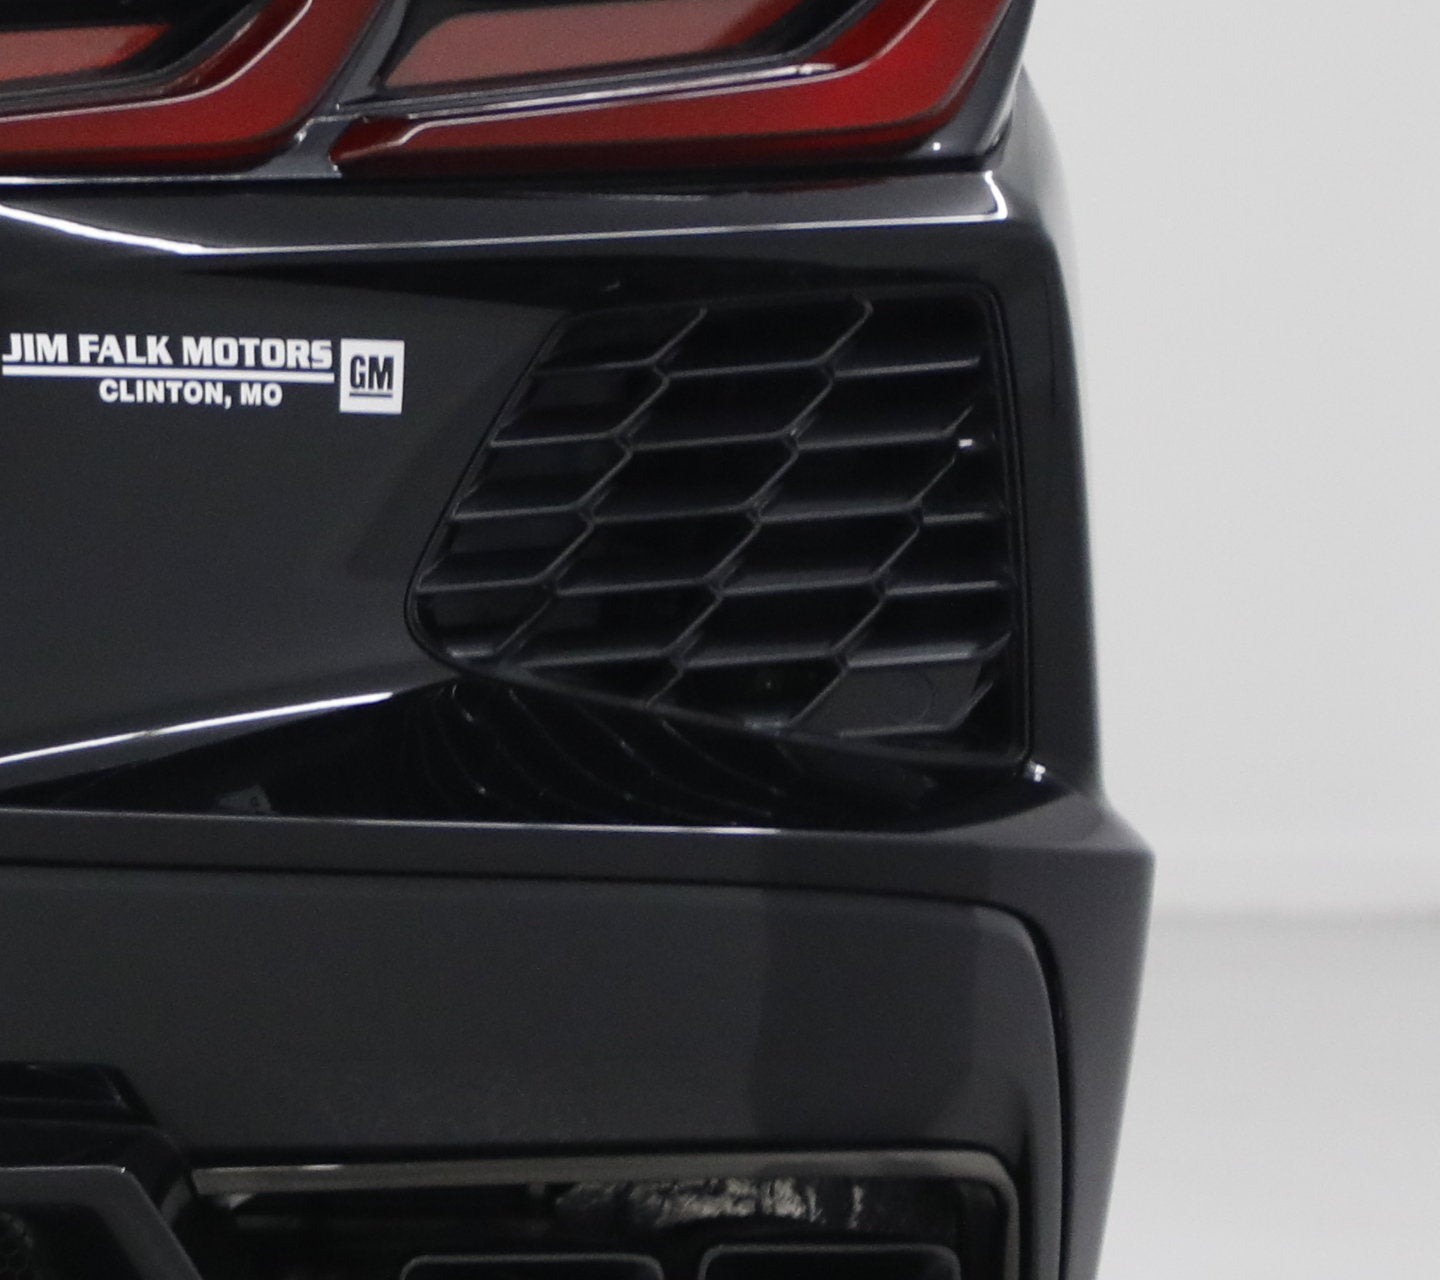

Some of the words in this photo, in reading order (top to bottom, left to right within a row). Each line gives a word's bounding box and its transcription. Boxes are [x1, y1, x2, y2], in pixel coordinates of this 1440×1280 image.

[2, 333, 68, 362] JIM
[78, 334, 173, 365] FALK
[182, 336, 332, 369] MOTORS
[349, 355, 394, 391] GM
[99, 378, 232, 409] CLINTON,
[240, 383, 282, 406] MO
